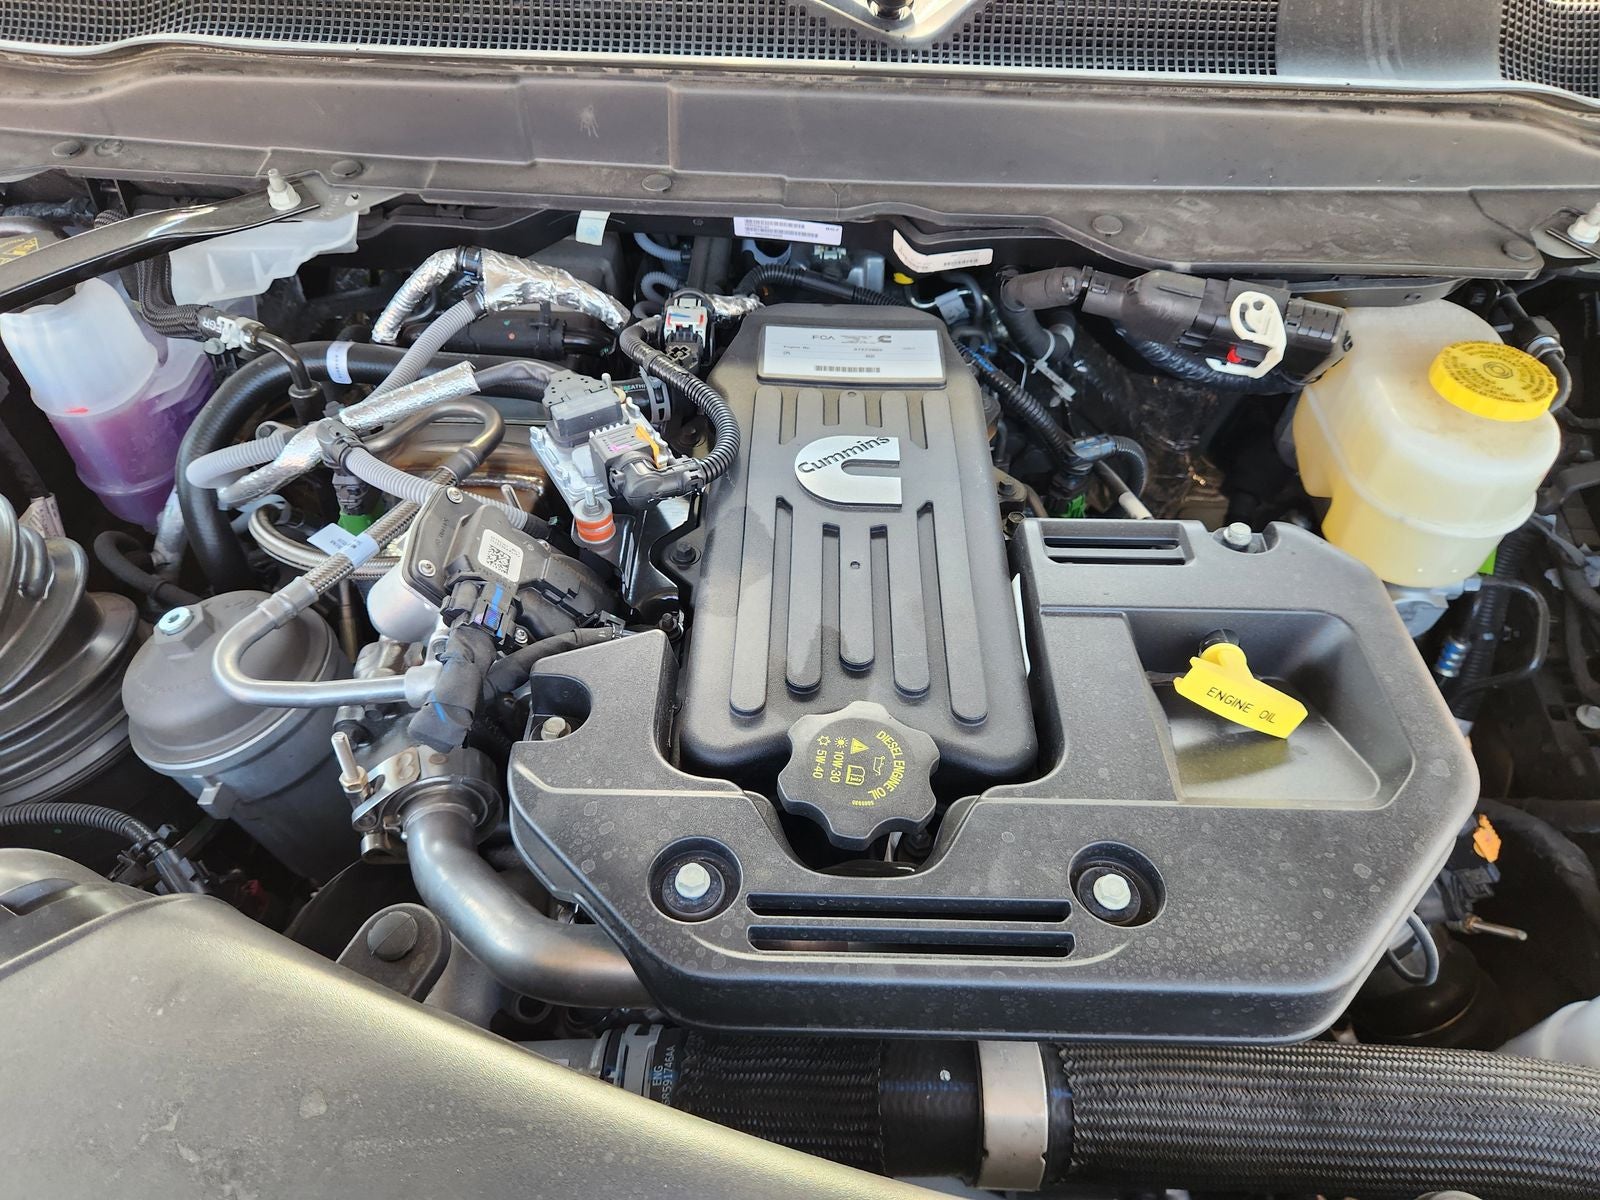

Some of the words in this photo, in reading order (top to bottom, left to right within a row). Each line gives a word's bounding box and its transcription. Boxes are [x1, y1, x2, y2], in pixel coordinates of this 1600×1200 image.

[797, 437, 890, 473] Cummins
[1206, 686, 1254, 714] ENGINE
[1258, 710, 1278, 724] OIL
[875, 730, 904, 759] DIESEL
[812, 749, 828, 779] 5W-40
[829, 750, 845, 783] 10W-30
[884, 760, 906, 792] ENGINE
[867, 787, 887, 800] OIL
[652, 1064, 664, 1087] ENG
